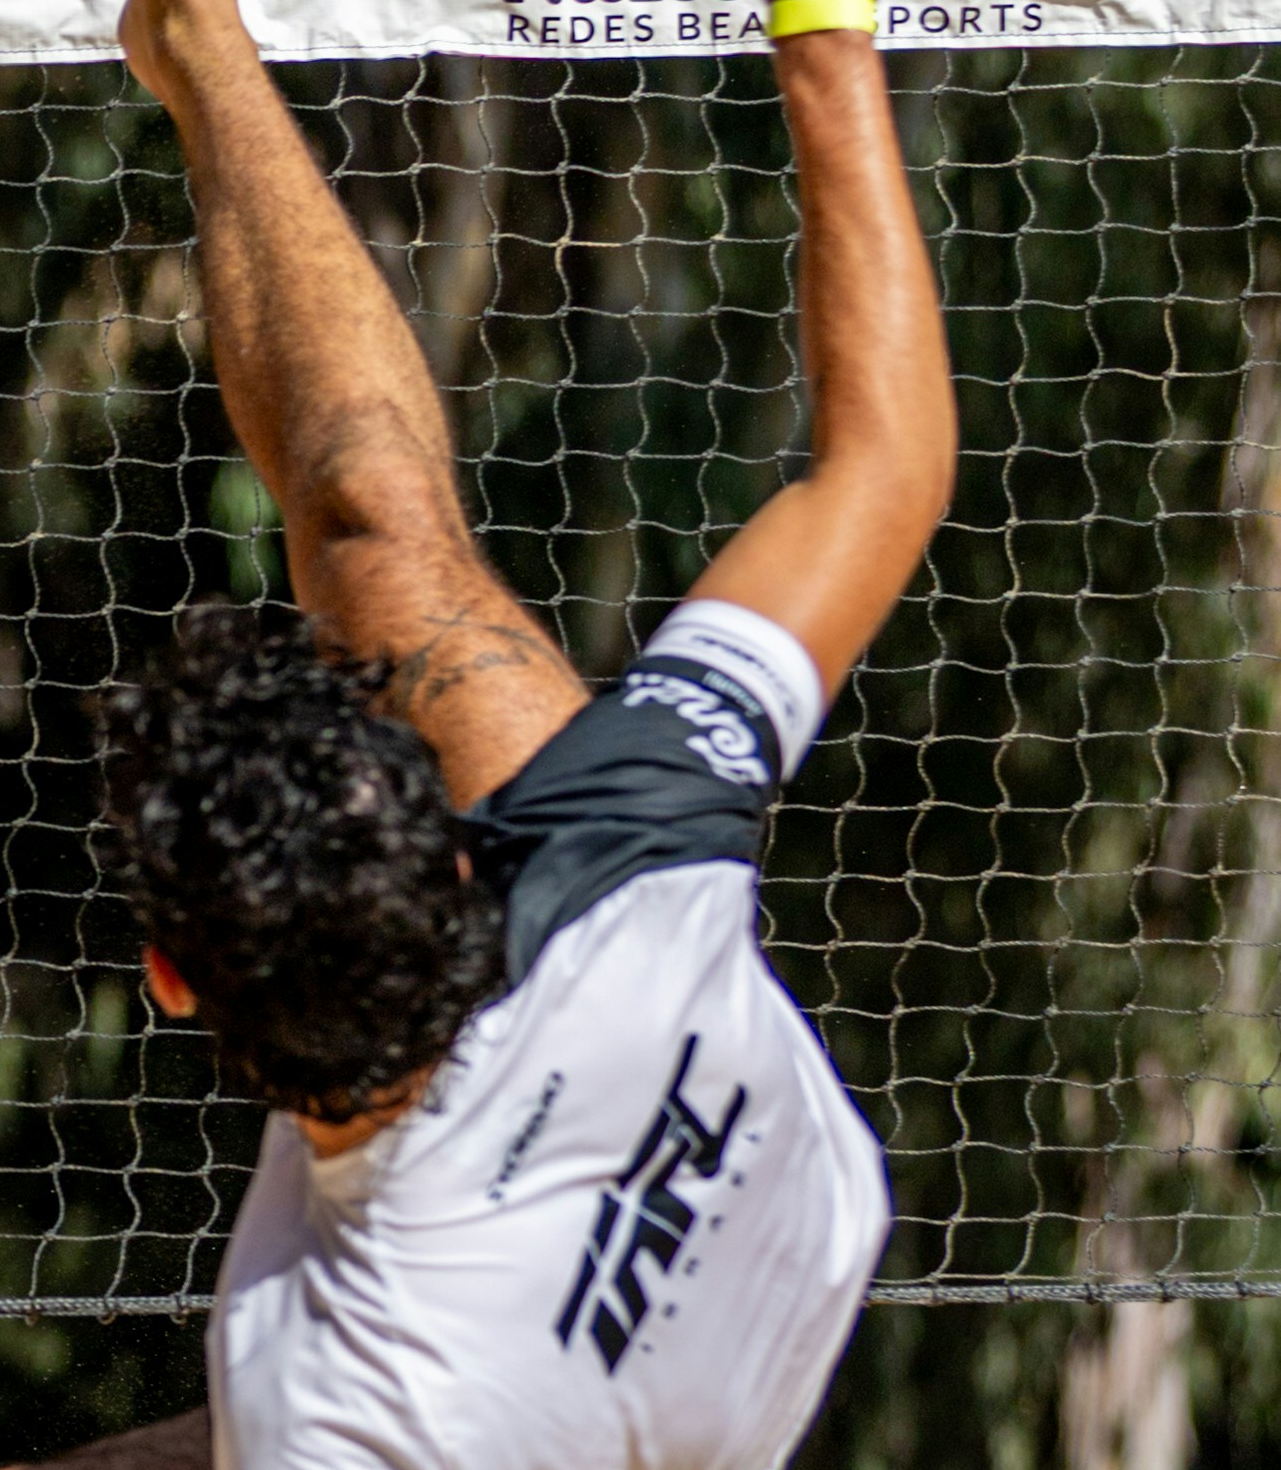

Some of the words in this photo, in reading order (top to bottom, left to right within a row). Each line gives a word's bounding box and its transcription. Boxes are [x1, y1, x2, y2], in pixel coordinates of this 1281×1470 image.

[508, 13, 655, 43] REDES
[679, 10, 766, 42] BEA
[876, 3, 1043, 35] PORTS
